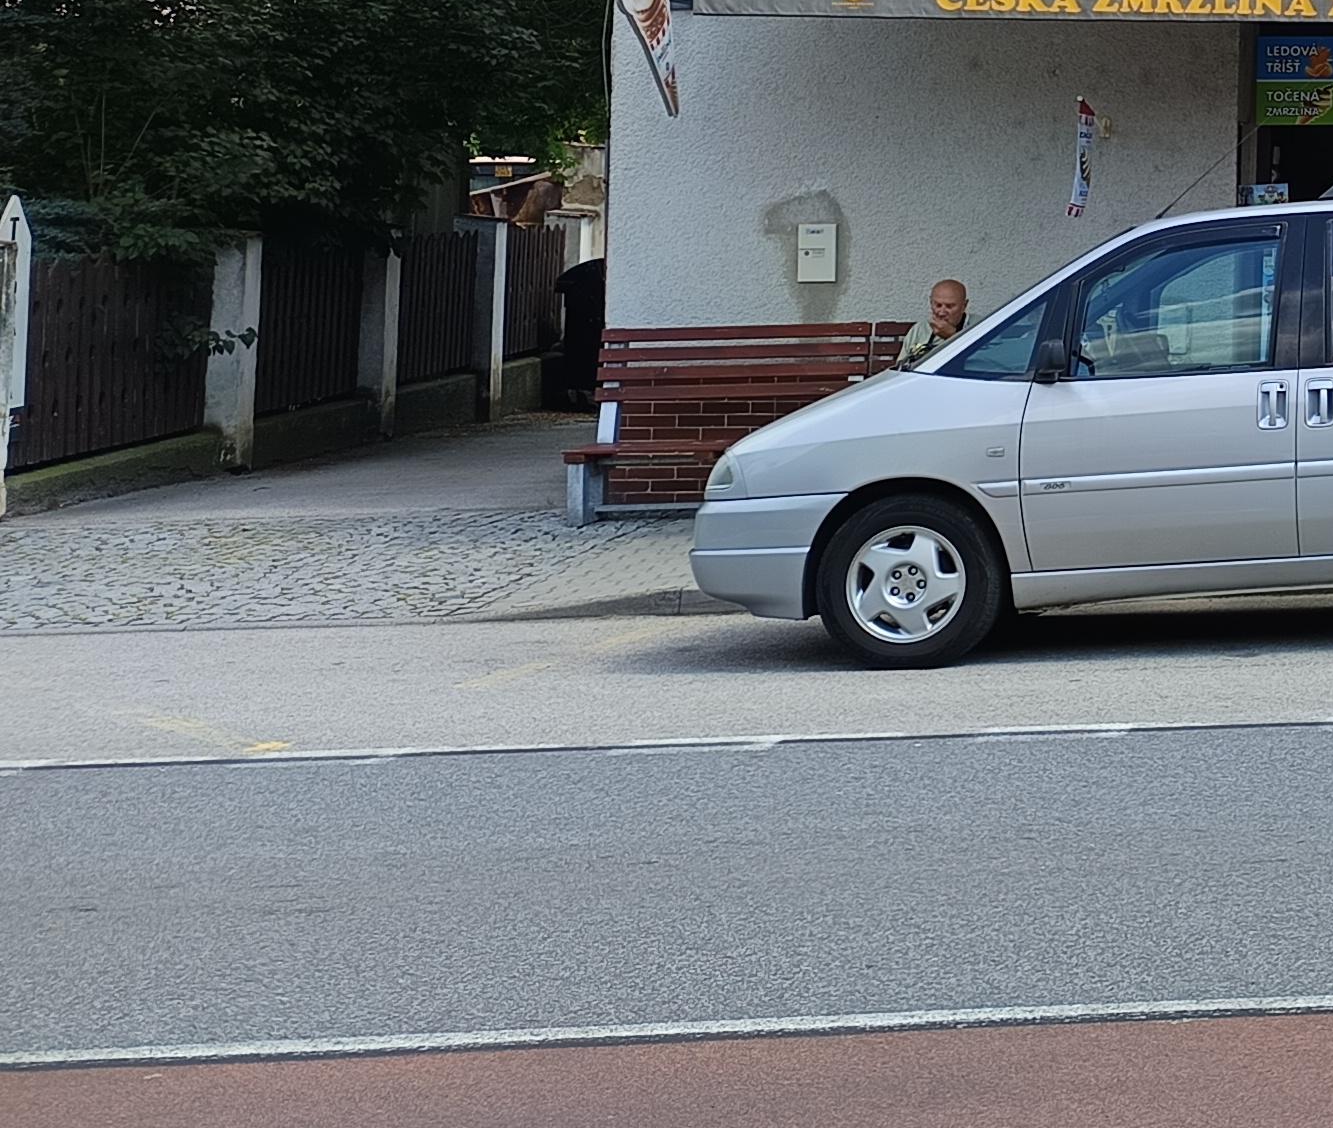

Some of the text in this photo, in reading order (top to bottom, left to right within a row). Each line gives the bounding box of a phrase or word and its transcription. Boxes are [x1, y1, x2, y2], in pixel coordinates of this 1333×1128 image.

[1266, 42, 1318, 56] LEDOVÁ
[1266, 59, 1301, 73] TŘÍŠŤ
[1266, 87, 1320, 102] TOČENÁ
[1266, 107, 1320, 117] ZMRZLINA
